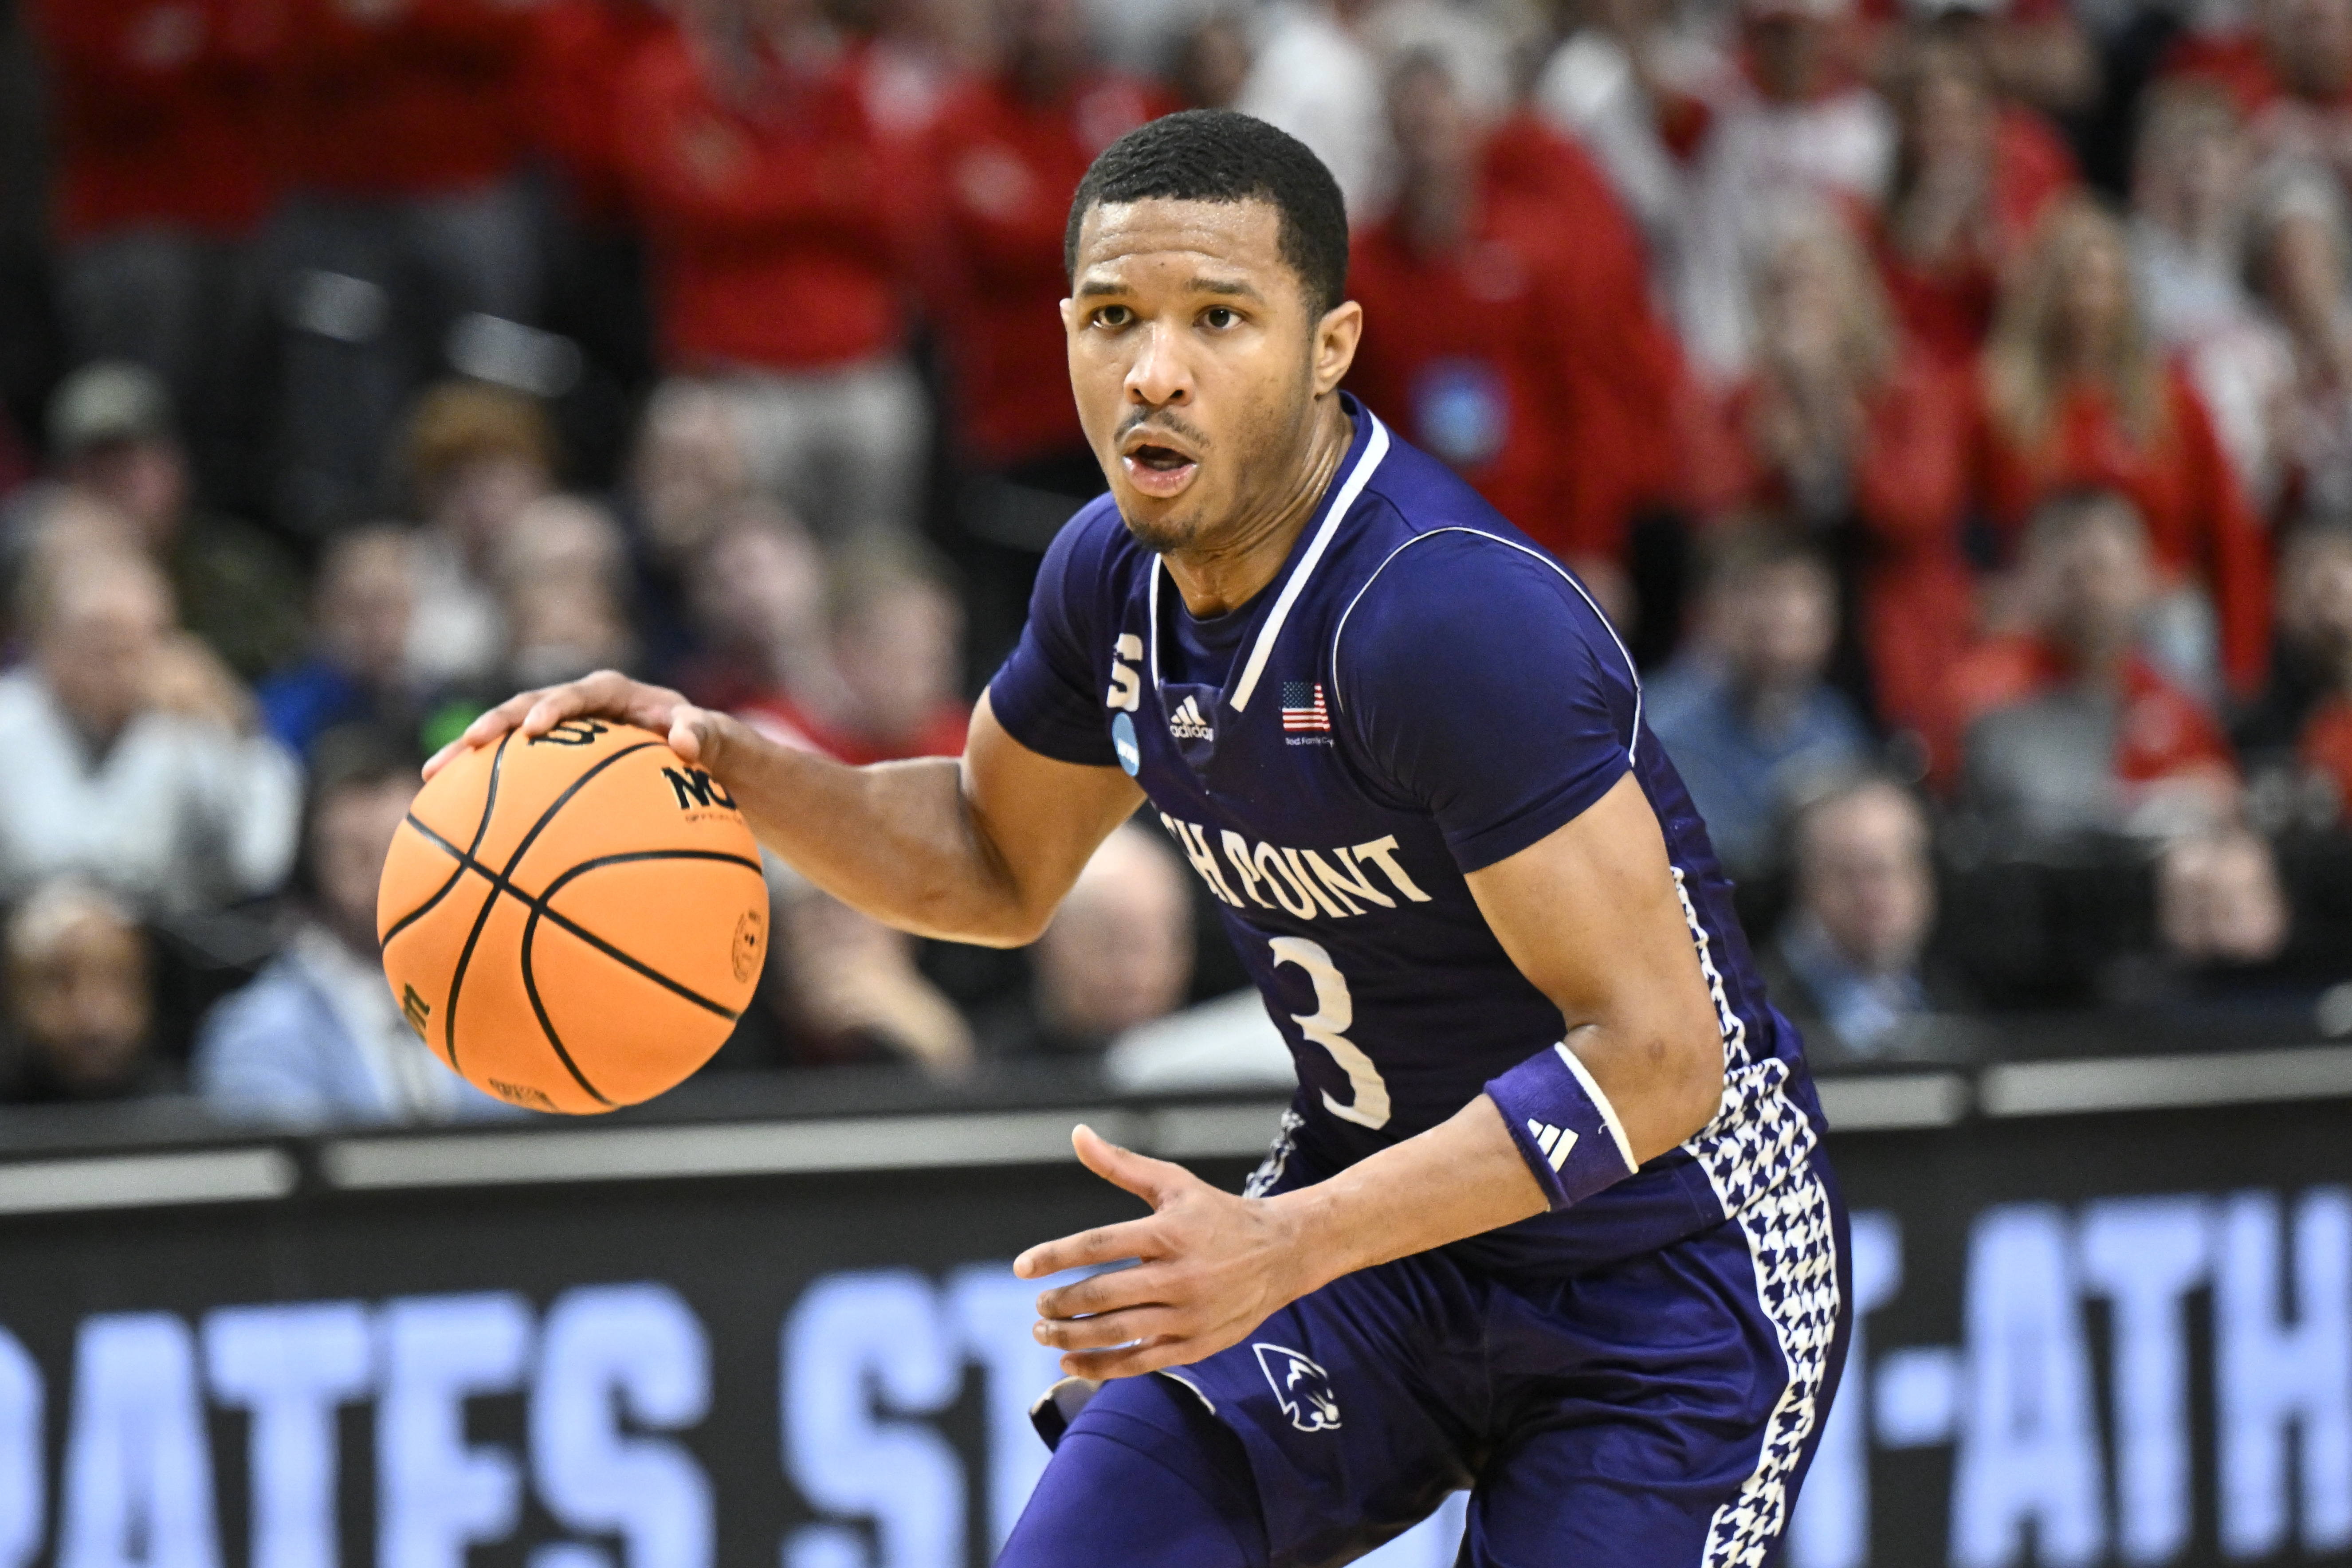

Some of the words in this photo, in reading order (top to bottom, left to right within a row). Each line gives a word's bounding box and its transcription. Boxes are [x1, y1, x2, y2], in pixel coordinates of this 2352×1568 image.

[1160, 811, 1245, 908] H
[1220, 834, 1433, 921] POINT
[1268, 936, 1392, 1131] 3
